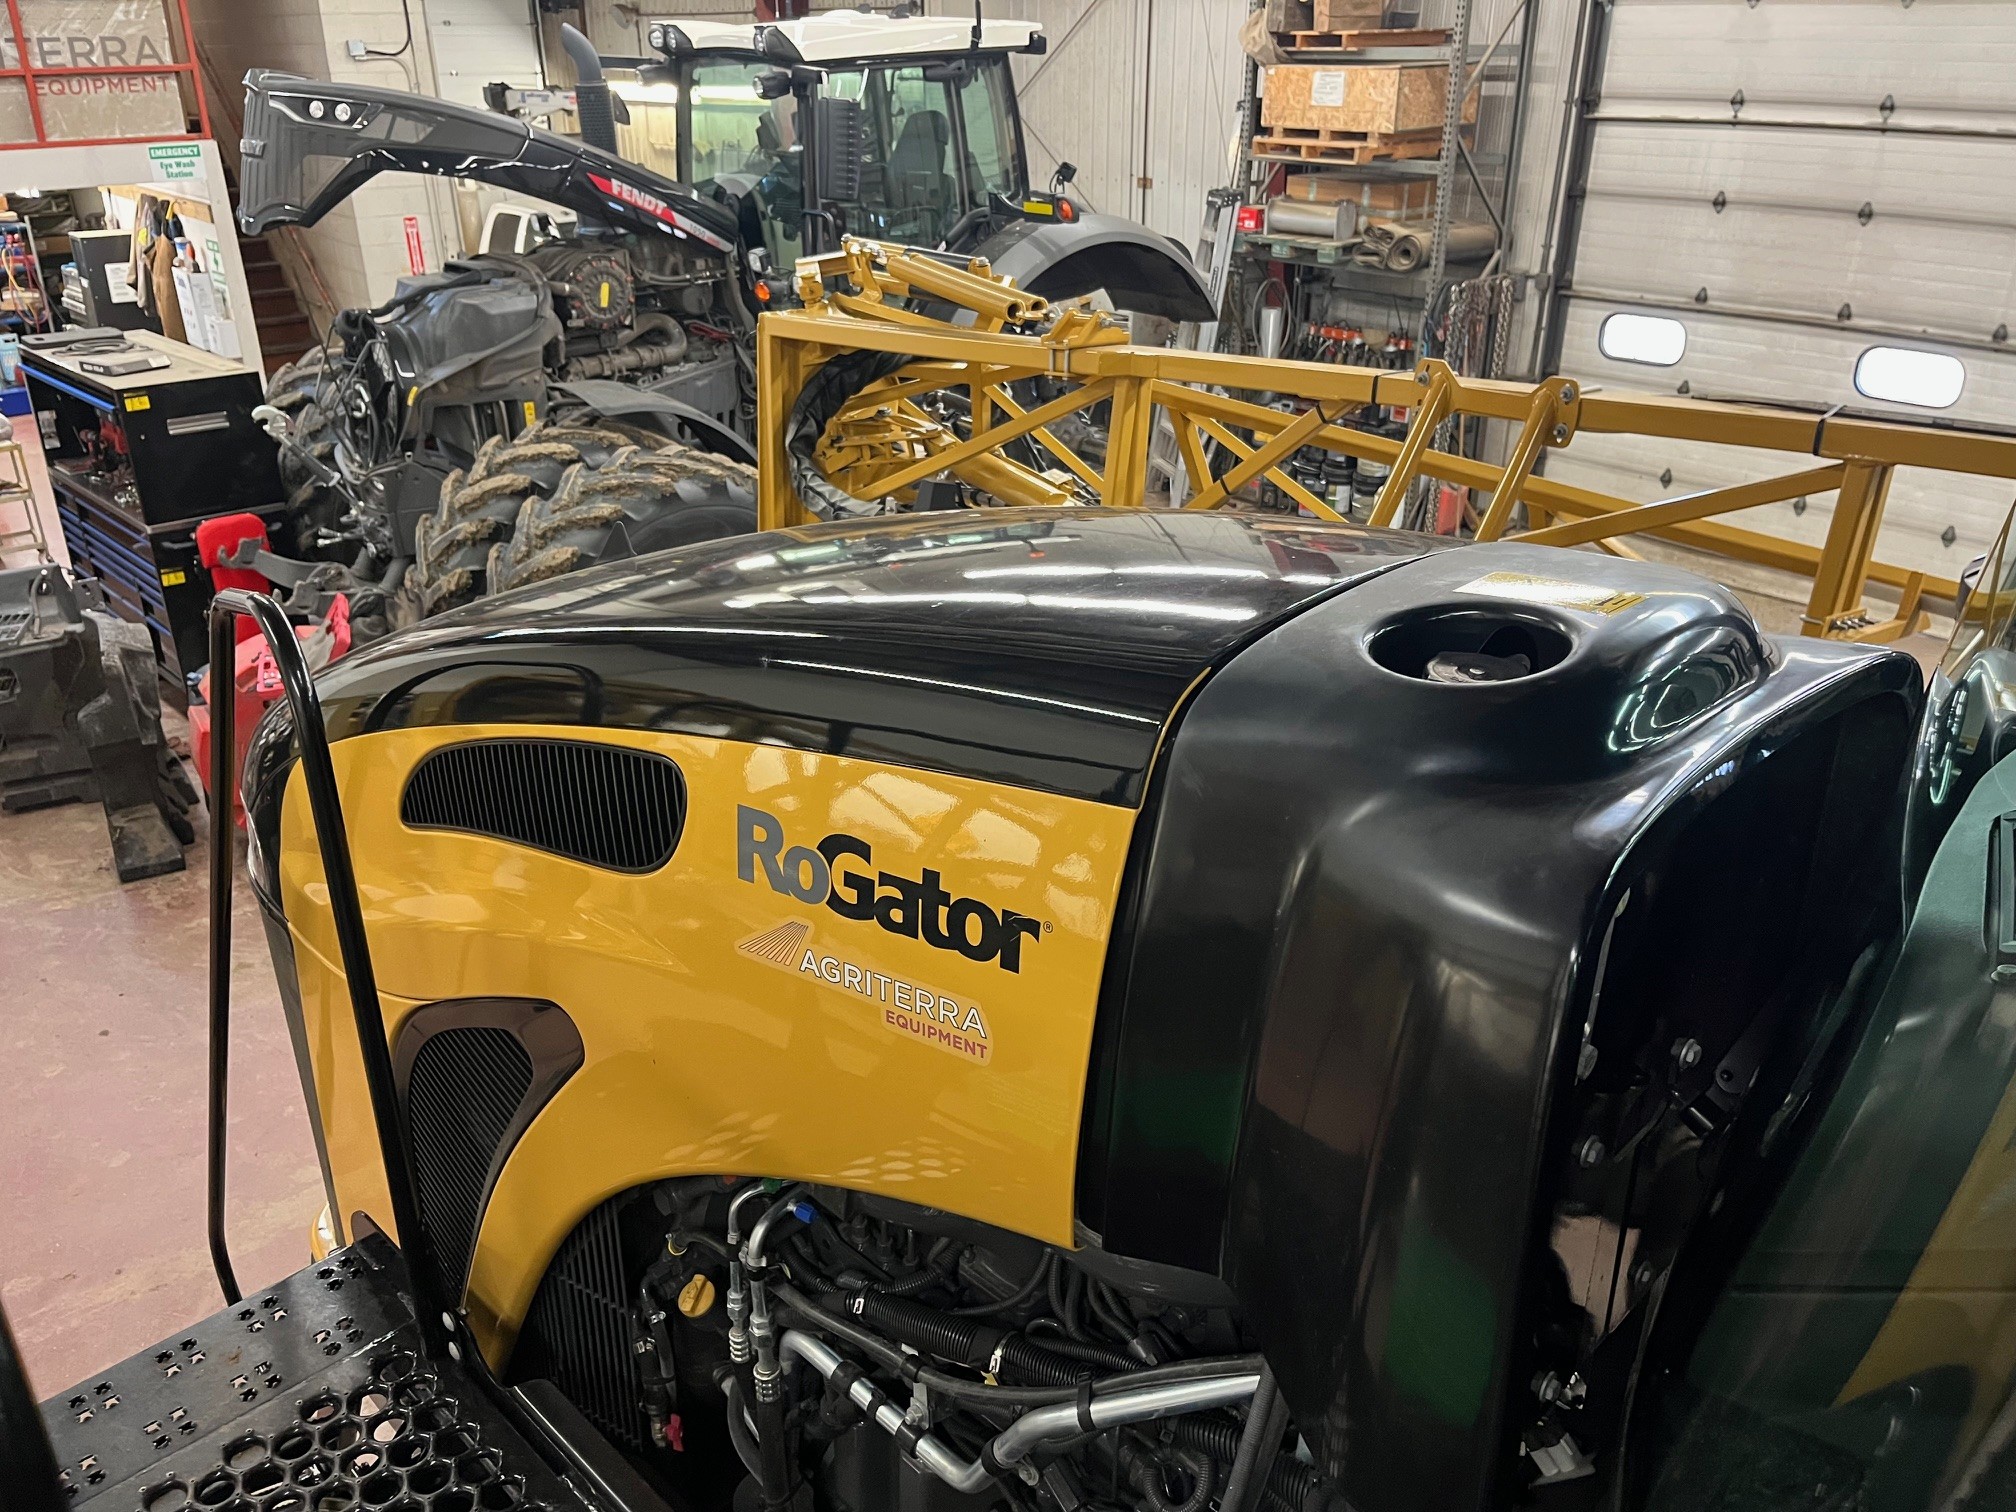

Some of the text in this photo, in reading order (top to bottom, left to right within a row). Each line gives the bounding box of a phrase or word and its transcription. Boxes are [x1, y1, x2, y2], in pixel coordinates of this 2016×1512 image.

[34, 76, 168, 96] EQUIPMENT
[151, 146, 198, 157] EMERGENCY
[160, 160, 195, 170] Eye Wash
[165, 170, 193, 178] Station
[611, 178, 667, 215] FENDT
[799, 949, 987, 1039] AGRITERRA
[885, 1009, 987, 1059] EQUIPMENT
